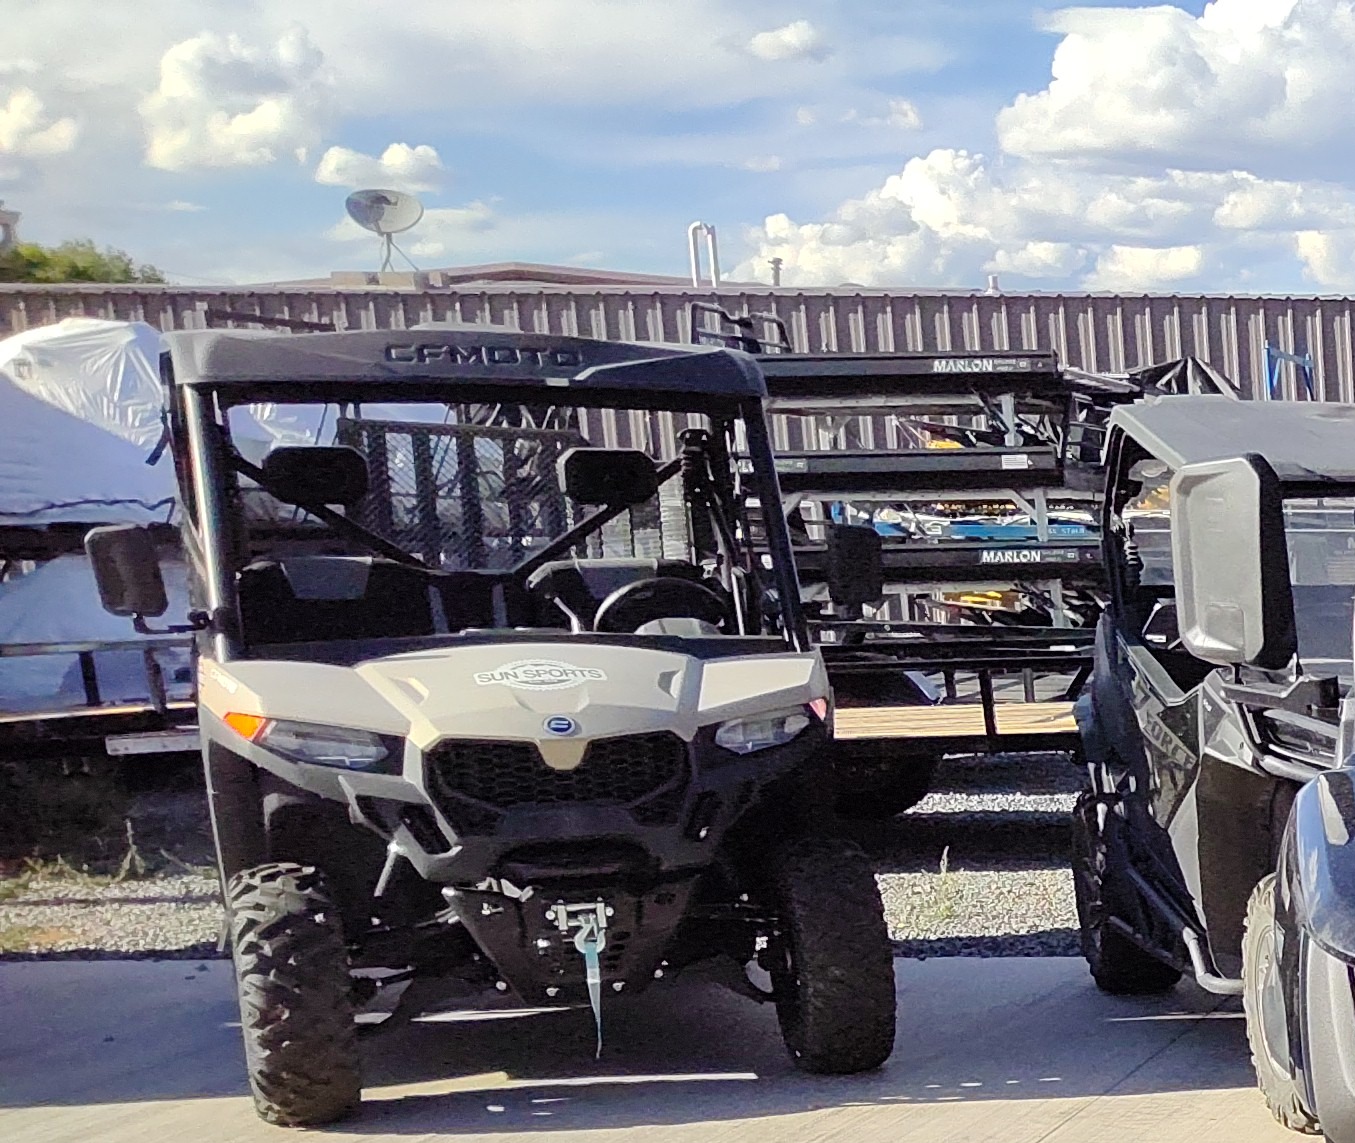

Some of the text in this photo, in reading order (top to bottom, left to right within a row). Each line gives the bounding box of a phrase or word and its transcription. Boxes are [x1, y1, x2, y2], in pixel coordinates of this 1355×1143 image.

[385, 342, 583, 368] CFMOTO
[933, 359, 993, 372] MARLON
[982, 549, 1041, 563] MARLON
[477, 667, 603, 683] SUN SPORTS
